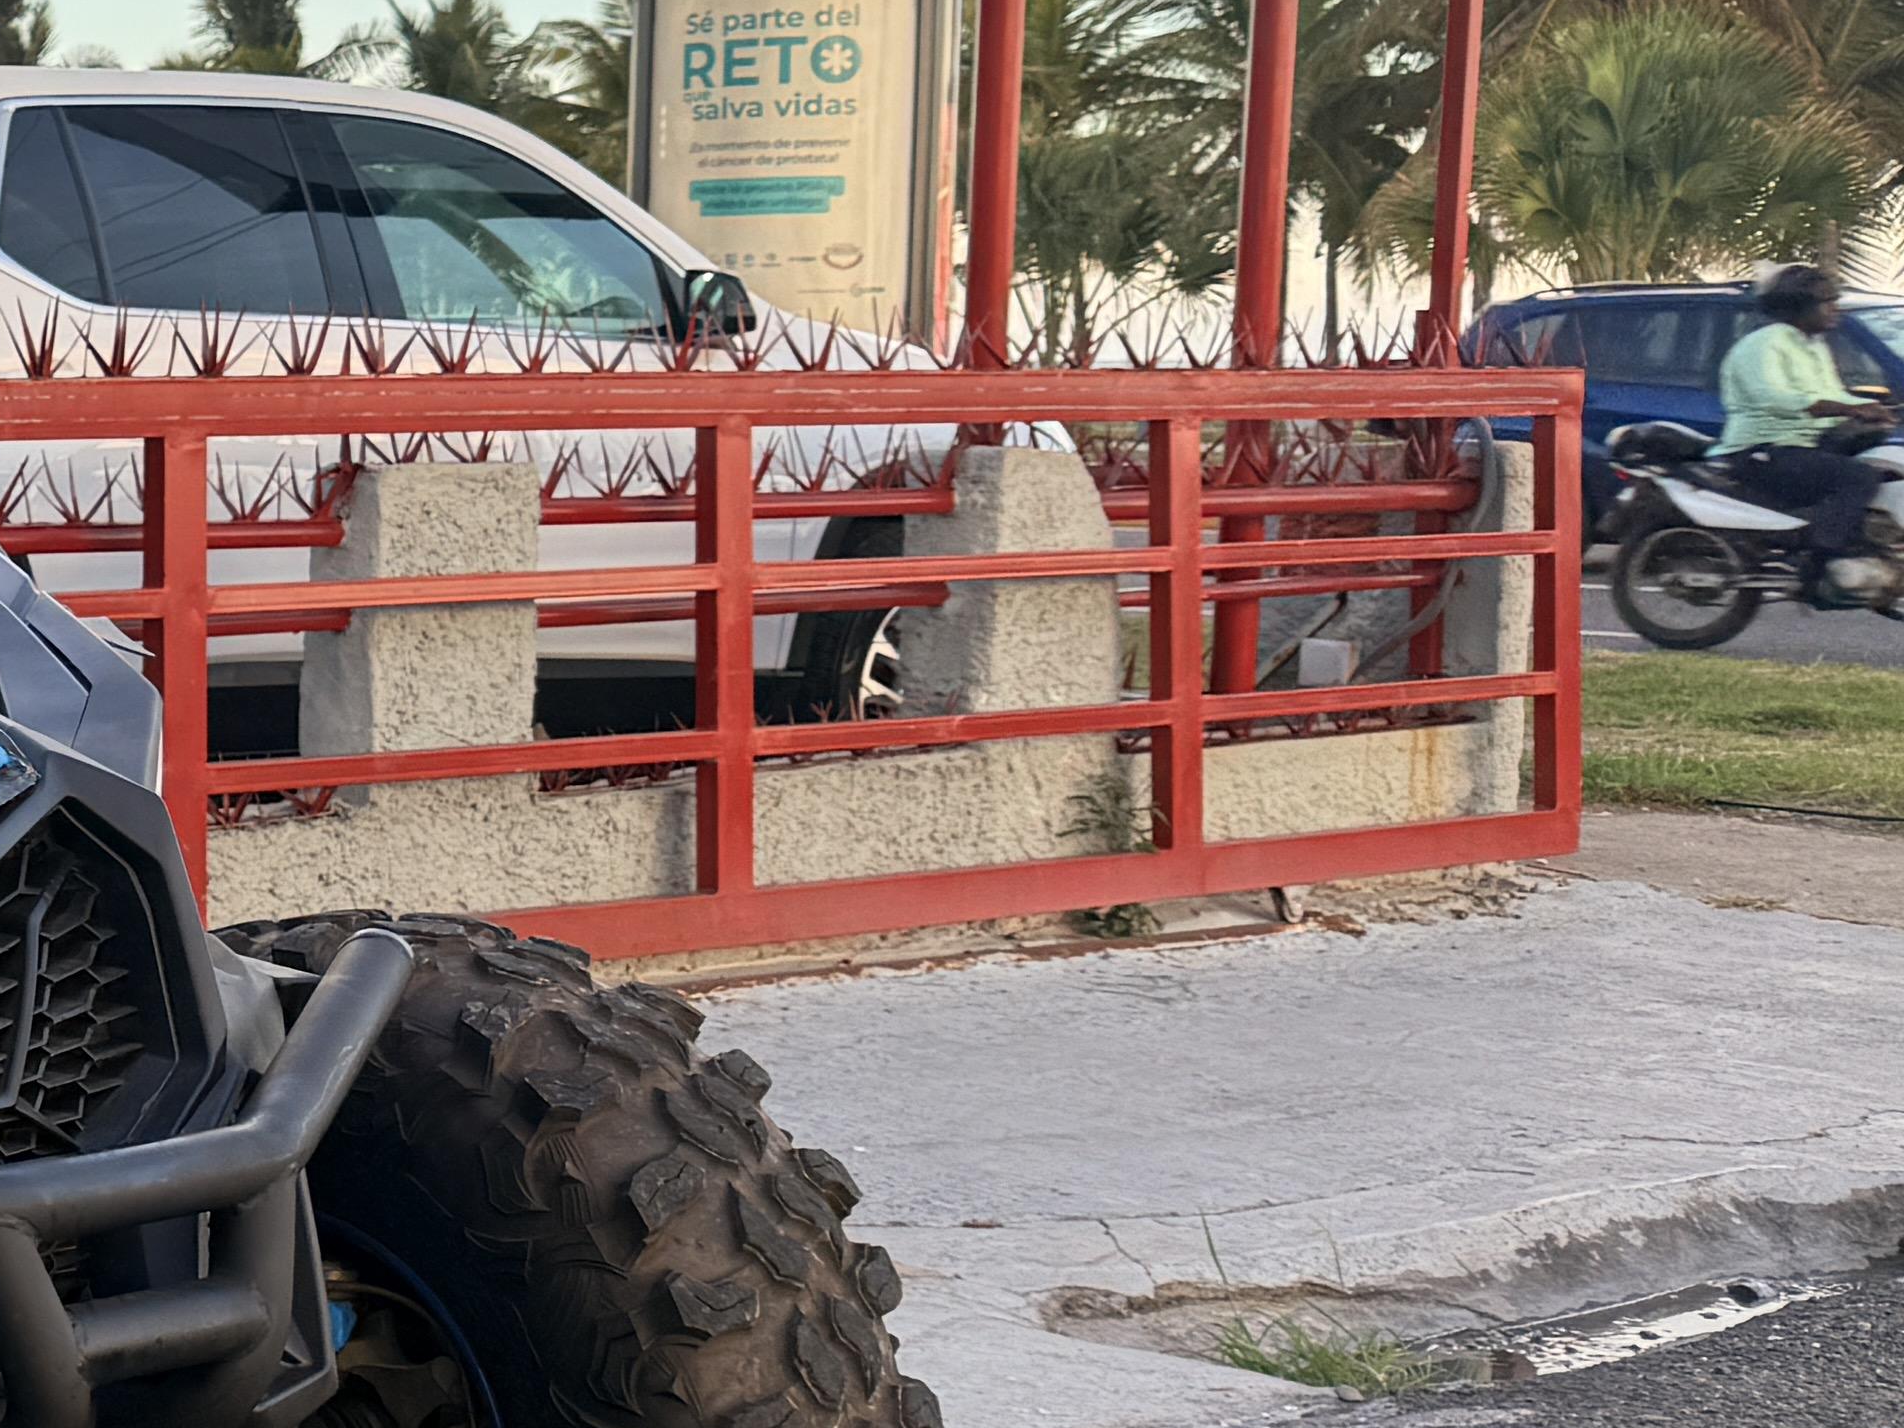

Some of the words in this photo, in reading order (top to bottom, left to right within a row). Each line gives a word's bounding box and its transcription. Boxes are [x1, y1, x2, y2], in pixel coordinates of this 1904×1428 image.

[686, 10, 714, 35] Sé
[723, 8, 805, 37] parte
[815, 3, 860, 27] del
[683, 35, 862, 90] RETO
[692, 97, 763, 121] salva
[774, 93, 858, 118] vidas
